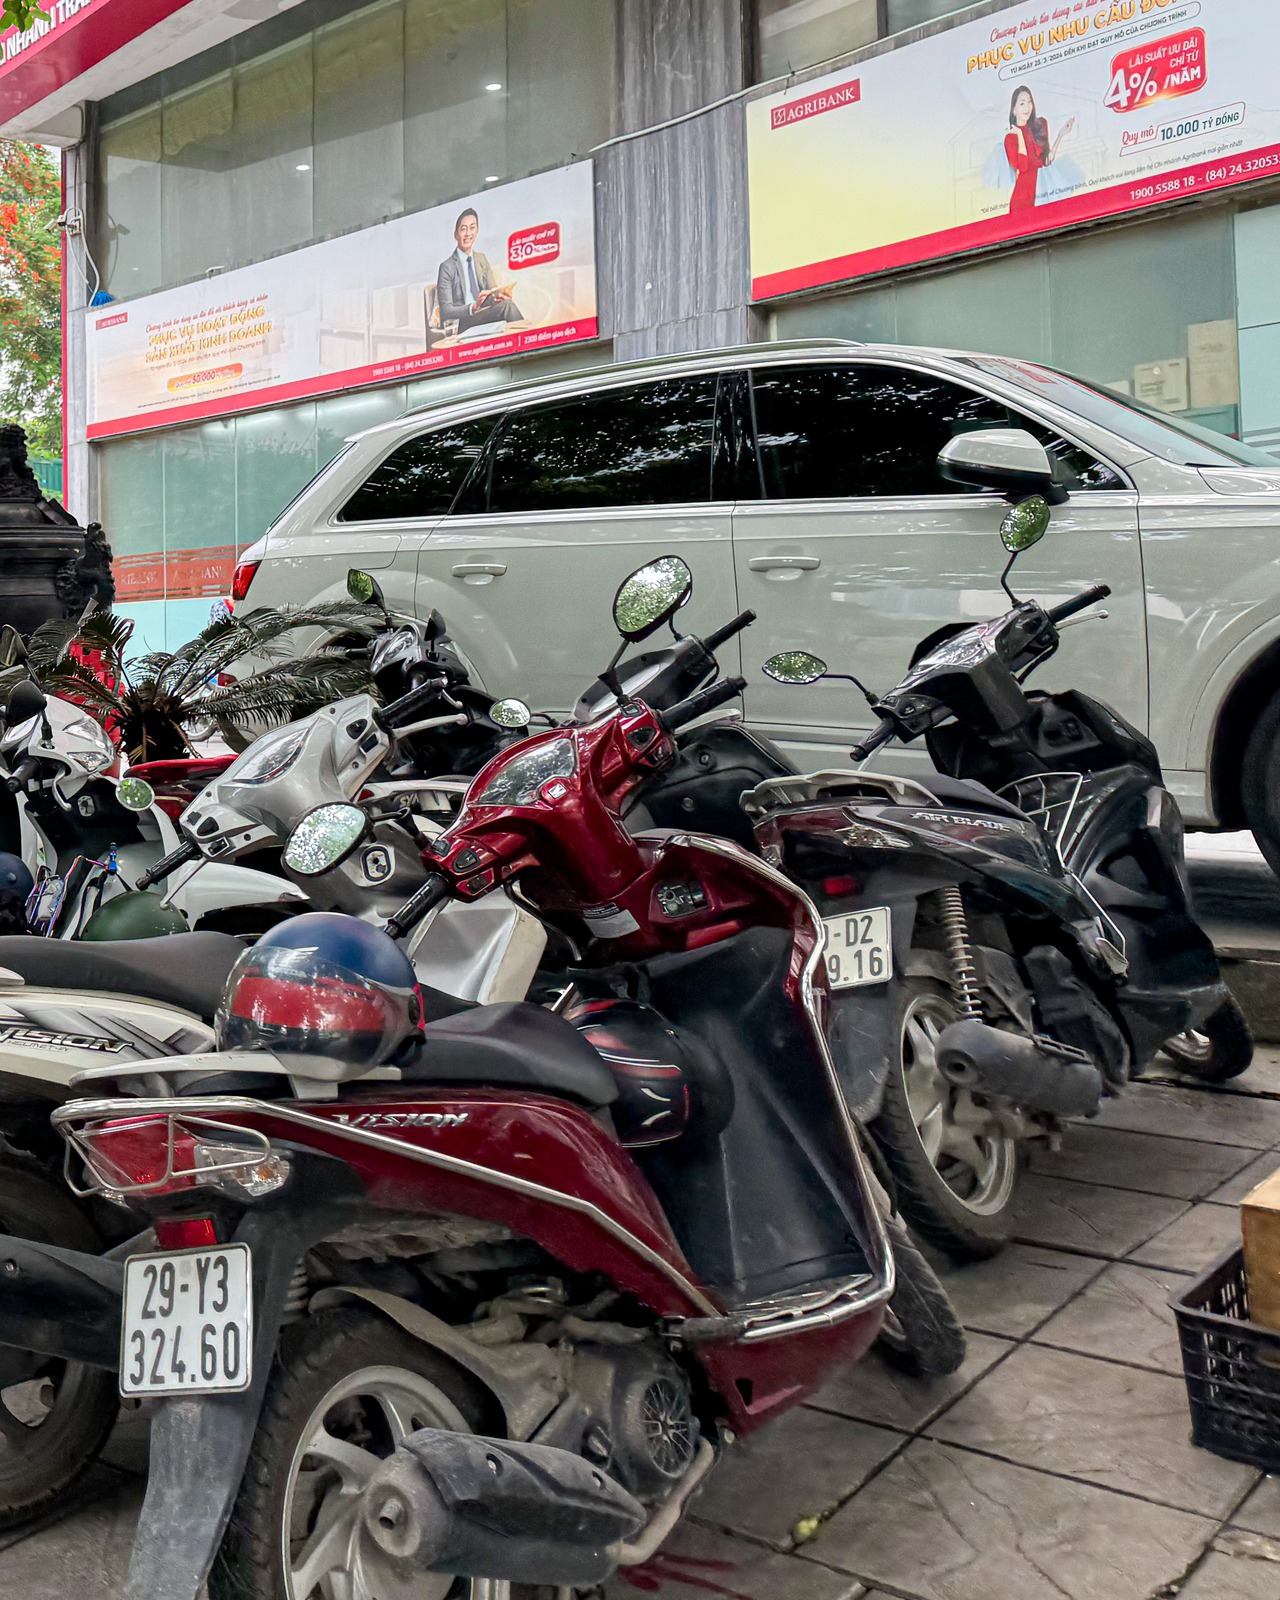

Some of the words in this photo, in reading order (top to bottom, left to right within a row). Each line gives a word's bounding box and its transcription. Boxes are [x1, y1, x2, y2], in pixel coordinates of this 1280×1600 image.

[967, 43, 1015, 74] PHỤC
[1018, 31, 1045, 55] VỤ
[1049, 16, 1090, 45] NHU
[1094, 1, 1136, 29] CẦU
[1018, 61, 1033, 72] NGÀY
[1064, 46, 1076, 57] ĐẾN
[1076, 43, 1087, 52] KHI
[1100, 34, 1113, 45] QUY
[1114, 30, 1125, 40] MÔ
[1126, 26, 1139, 36] CỦA
[1140, 16, 1167, 31] CHƯƠNG
[1168, 10, 1187, 22] TRÌNH
[1129, 54, 1144, 68] LÃI
[1144, 46, 1167, 63] SUẤT
[1168, 42, 1182, 56] ƯU
[1182, 37, 1199, 51] ĐÃI
[1170, 55, 1186, 68] CHỈ
[1186, 49, 1200, 64] TỪ
[787, 87, 855, 121] AGRIBANK
[1104, 66, 1158, 108] 4%
[1122, 130, 1139, 145] Quy
[1140, 125, 1155, 138] mô
[1161, 119, 1200, 141] 10.000
[1215, 111, 1240, 127] ĐỒNG
[1182, 150, 1206, 162] Agribank
[1129, 186, 1153, 200] 1900
[1155, 179, 1180, 194] 5588
[1183, 176, 1195, 187] 18
[1205, 167, 1226, 183] (84)
[1229, 154, 1280, 176] 24.32053
[179, 324, 195, 340] VỤ
[196, 315, 228, 334] HOẠT
[230, 305, 266, 326] ĐỘNG
[199, 332, 227, 351] KINH
[229, 320, 273, 343] DOANH
[910, 812, 950, 823] AIR
[950, 815, 1010, 832] BLADE
[332, 1112, 469, 1128] VISION
[141, 1255, 229, 1320] 29-Y3
[129, 1321, 240, 1386] 324.60
